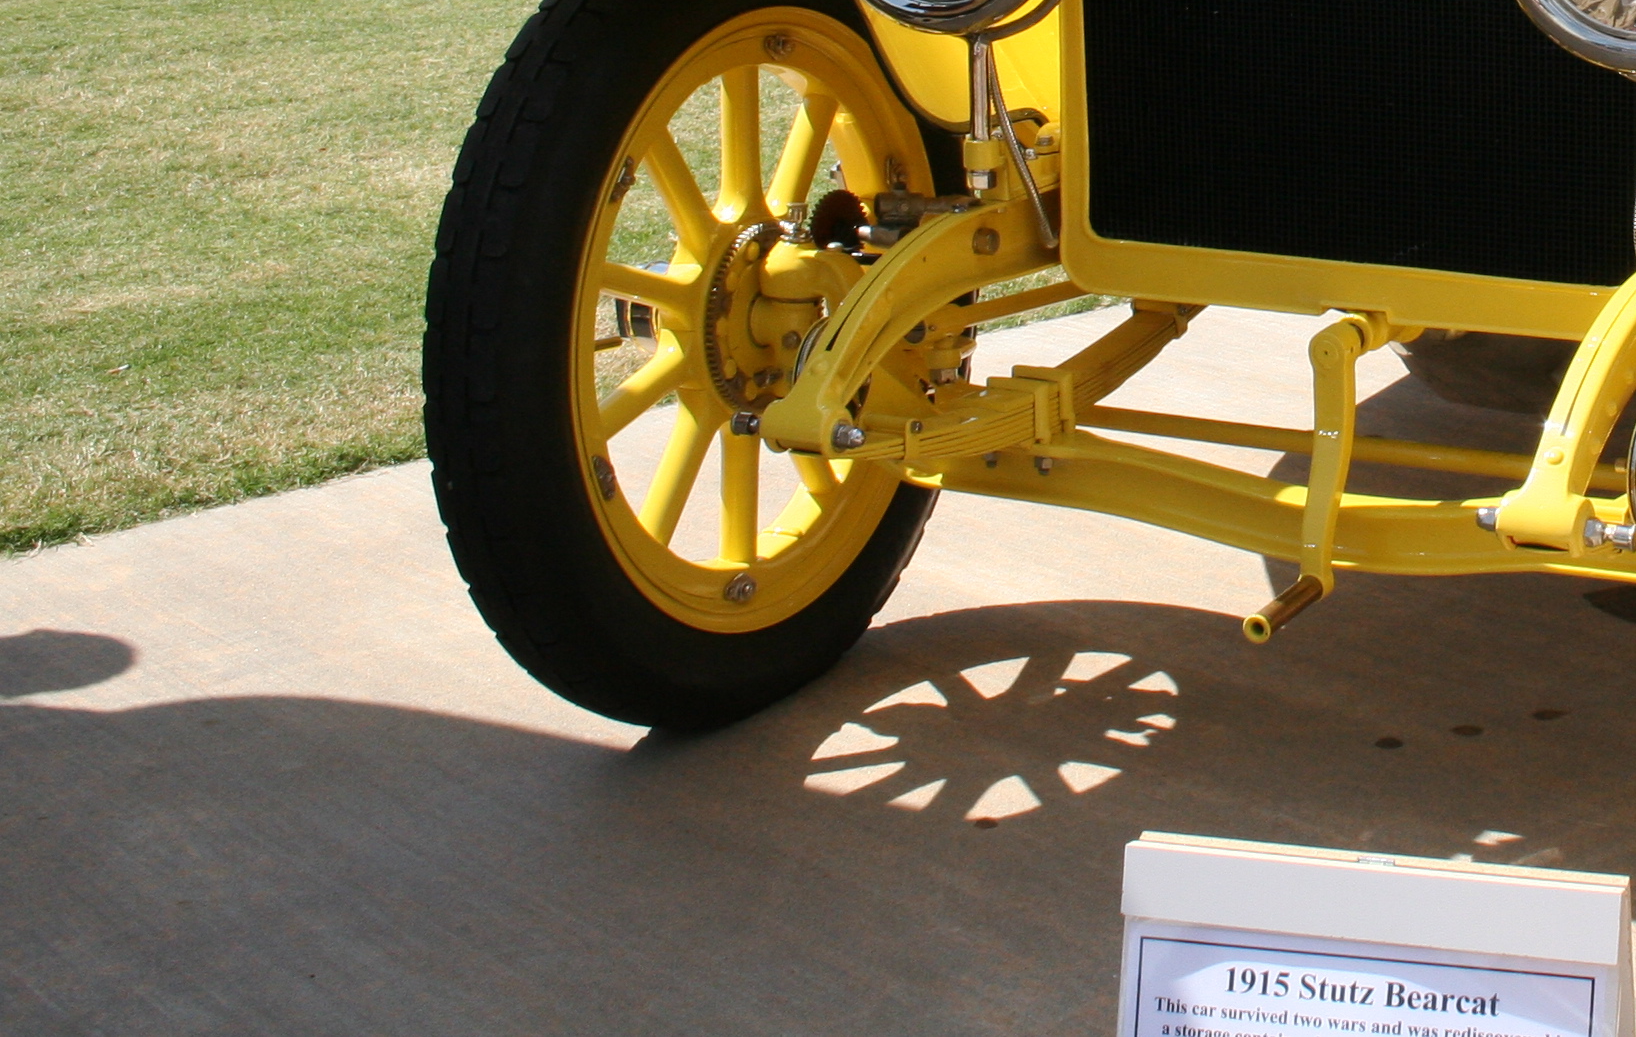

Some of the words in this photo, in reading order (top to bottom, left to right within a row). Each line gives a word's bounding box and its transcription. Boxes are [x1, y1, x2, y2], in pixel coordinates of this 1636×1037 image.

[1225, 966, 1290, 997] 1915
[1299, 973, 1374, 1005] Stutz
[1385, 981, 1500, 1017] Bearcat
[1155, 996, 1187, 1014] This
[1192, 1004, 1216, 1017] car
[1220, 1006, 1288, 1025] survived
[1293, 1012, 1322, 1028] two
[1328, 1017, 1366, 1032] wars
[1371, 1021, 1402, 1036] and
[1407, 1025, 1439, 1037] was
[1161, 1024, 1170, 1035] a
